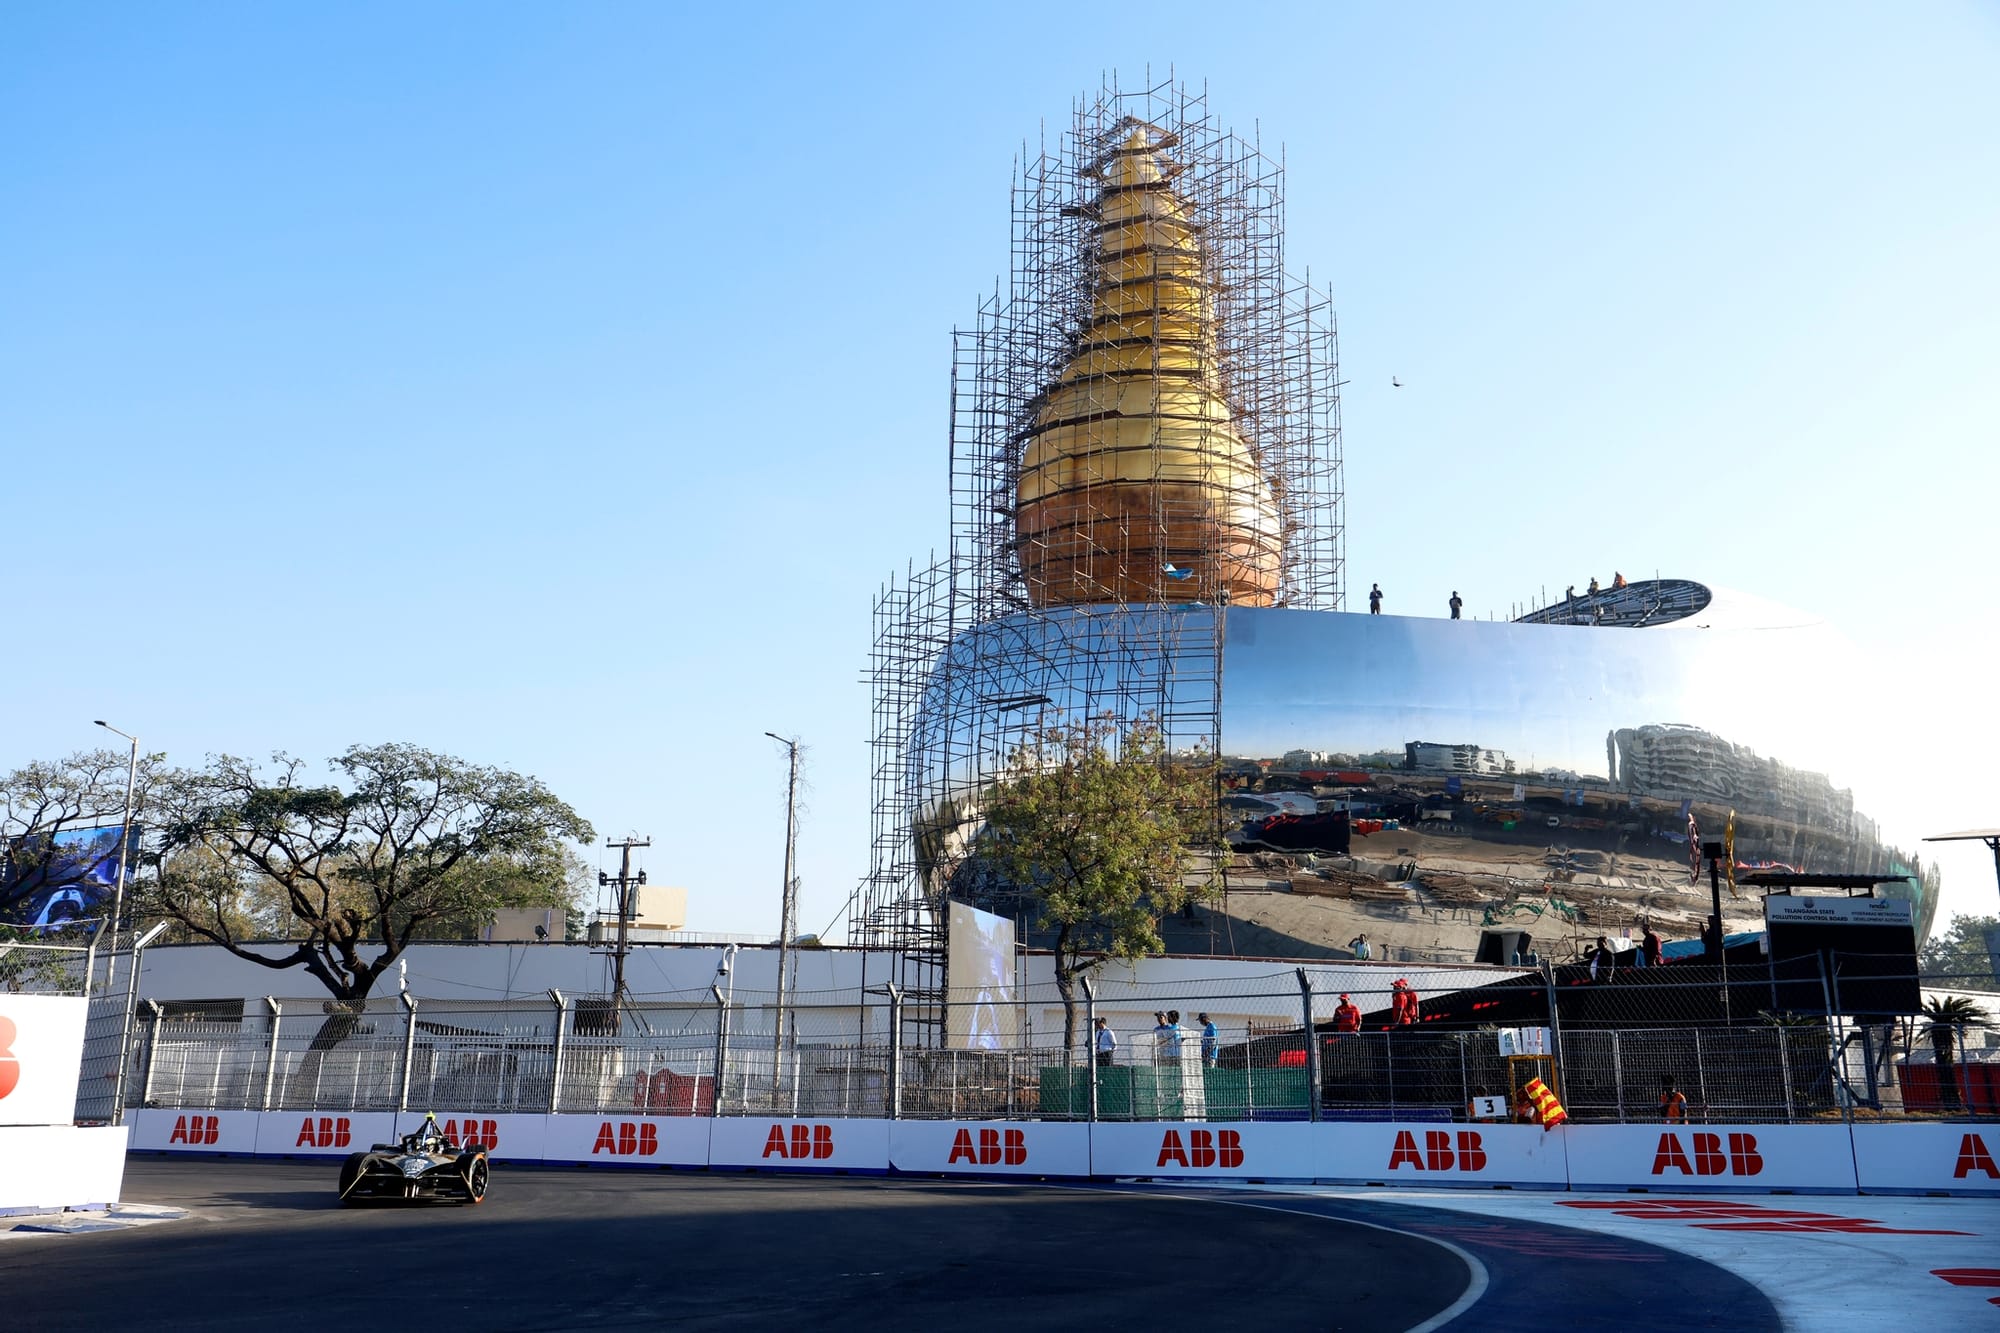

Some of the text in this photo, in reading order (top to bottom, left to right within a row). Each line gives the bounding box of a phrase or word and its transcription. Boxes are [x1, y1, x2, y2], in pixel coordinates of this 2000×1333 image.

[1484, 1099, 1494, 1113] 3
[170, 1115, 218, 1145] ABB
[296, 1117, 350, 1148] ABB
[443, 1119, 498, 1151] ABB
[592, 1122, 658, 1156] ABB
[762, 1124, 834, 1160] ABB
[948, 1128, 1027, 1165] ABB
[1157, 1129, 1244, 1168] ABB
[1389, 1130, 1487, 1171] ABB
[1651, 1132, 1764, 1176] ABB
